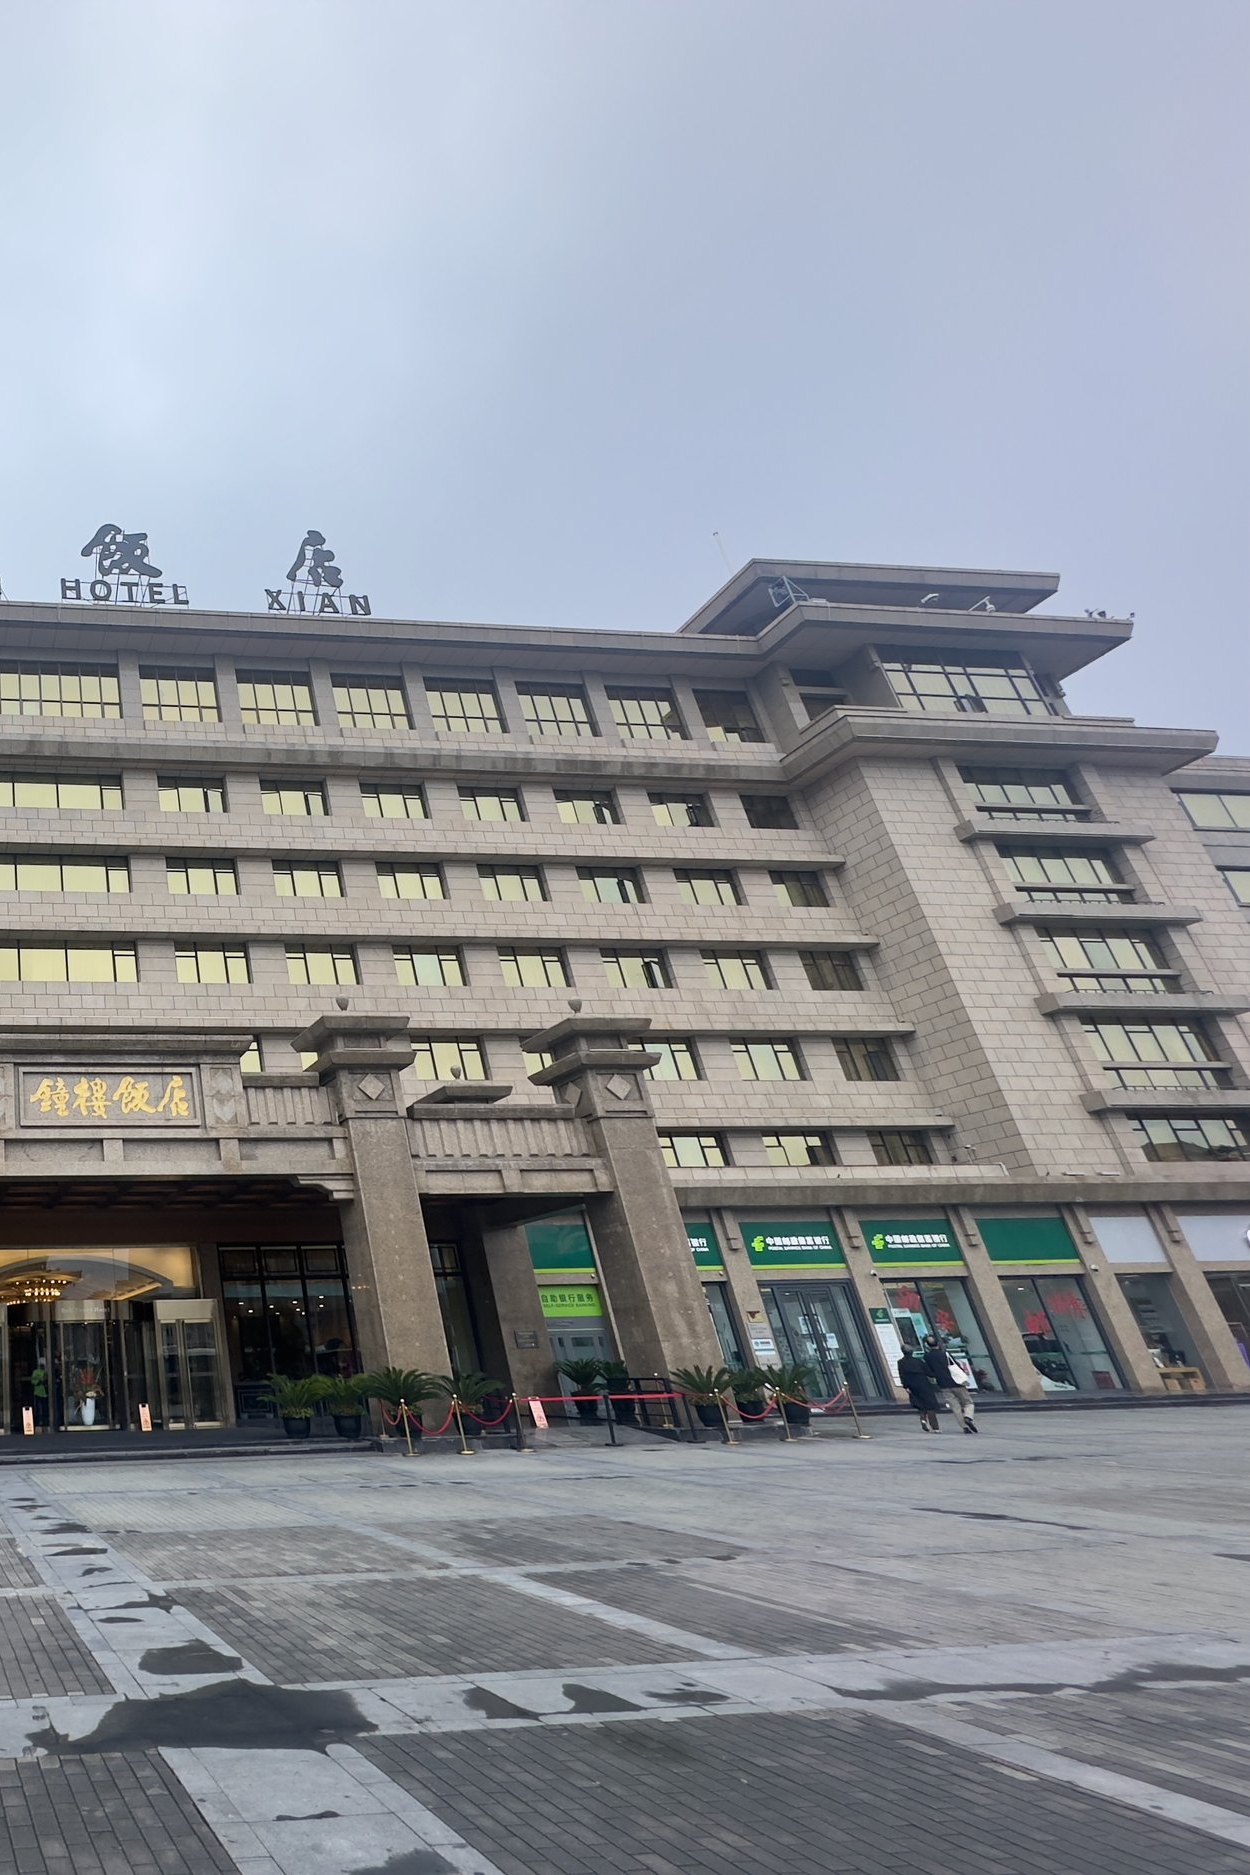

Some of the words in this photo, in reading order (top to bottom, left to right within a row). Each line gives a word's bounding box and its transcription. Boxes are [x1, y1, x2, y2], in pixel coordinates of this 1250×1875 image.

[61, 578, 189, 604] HOTEL
[265, 589, 371, 615] XIAN
[29, 1075, 190, 1119] 鐘樓飯店
